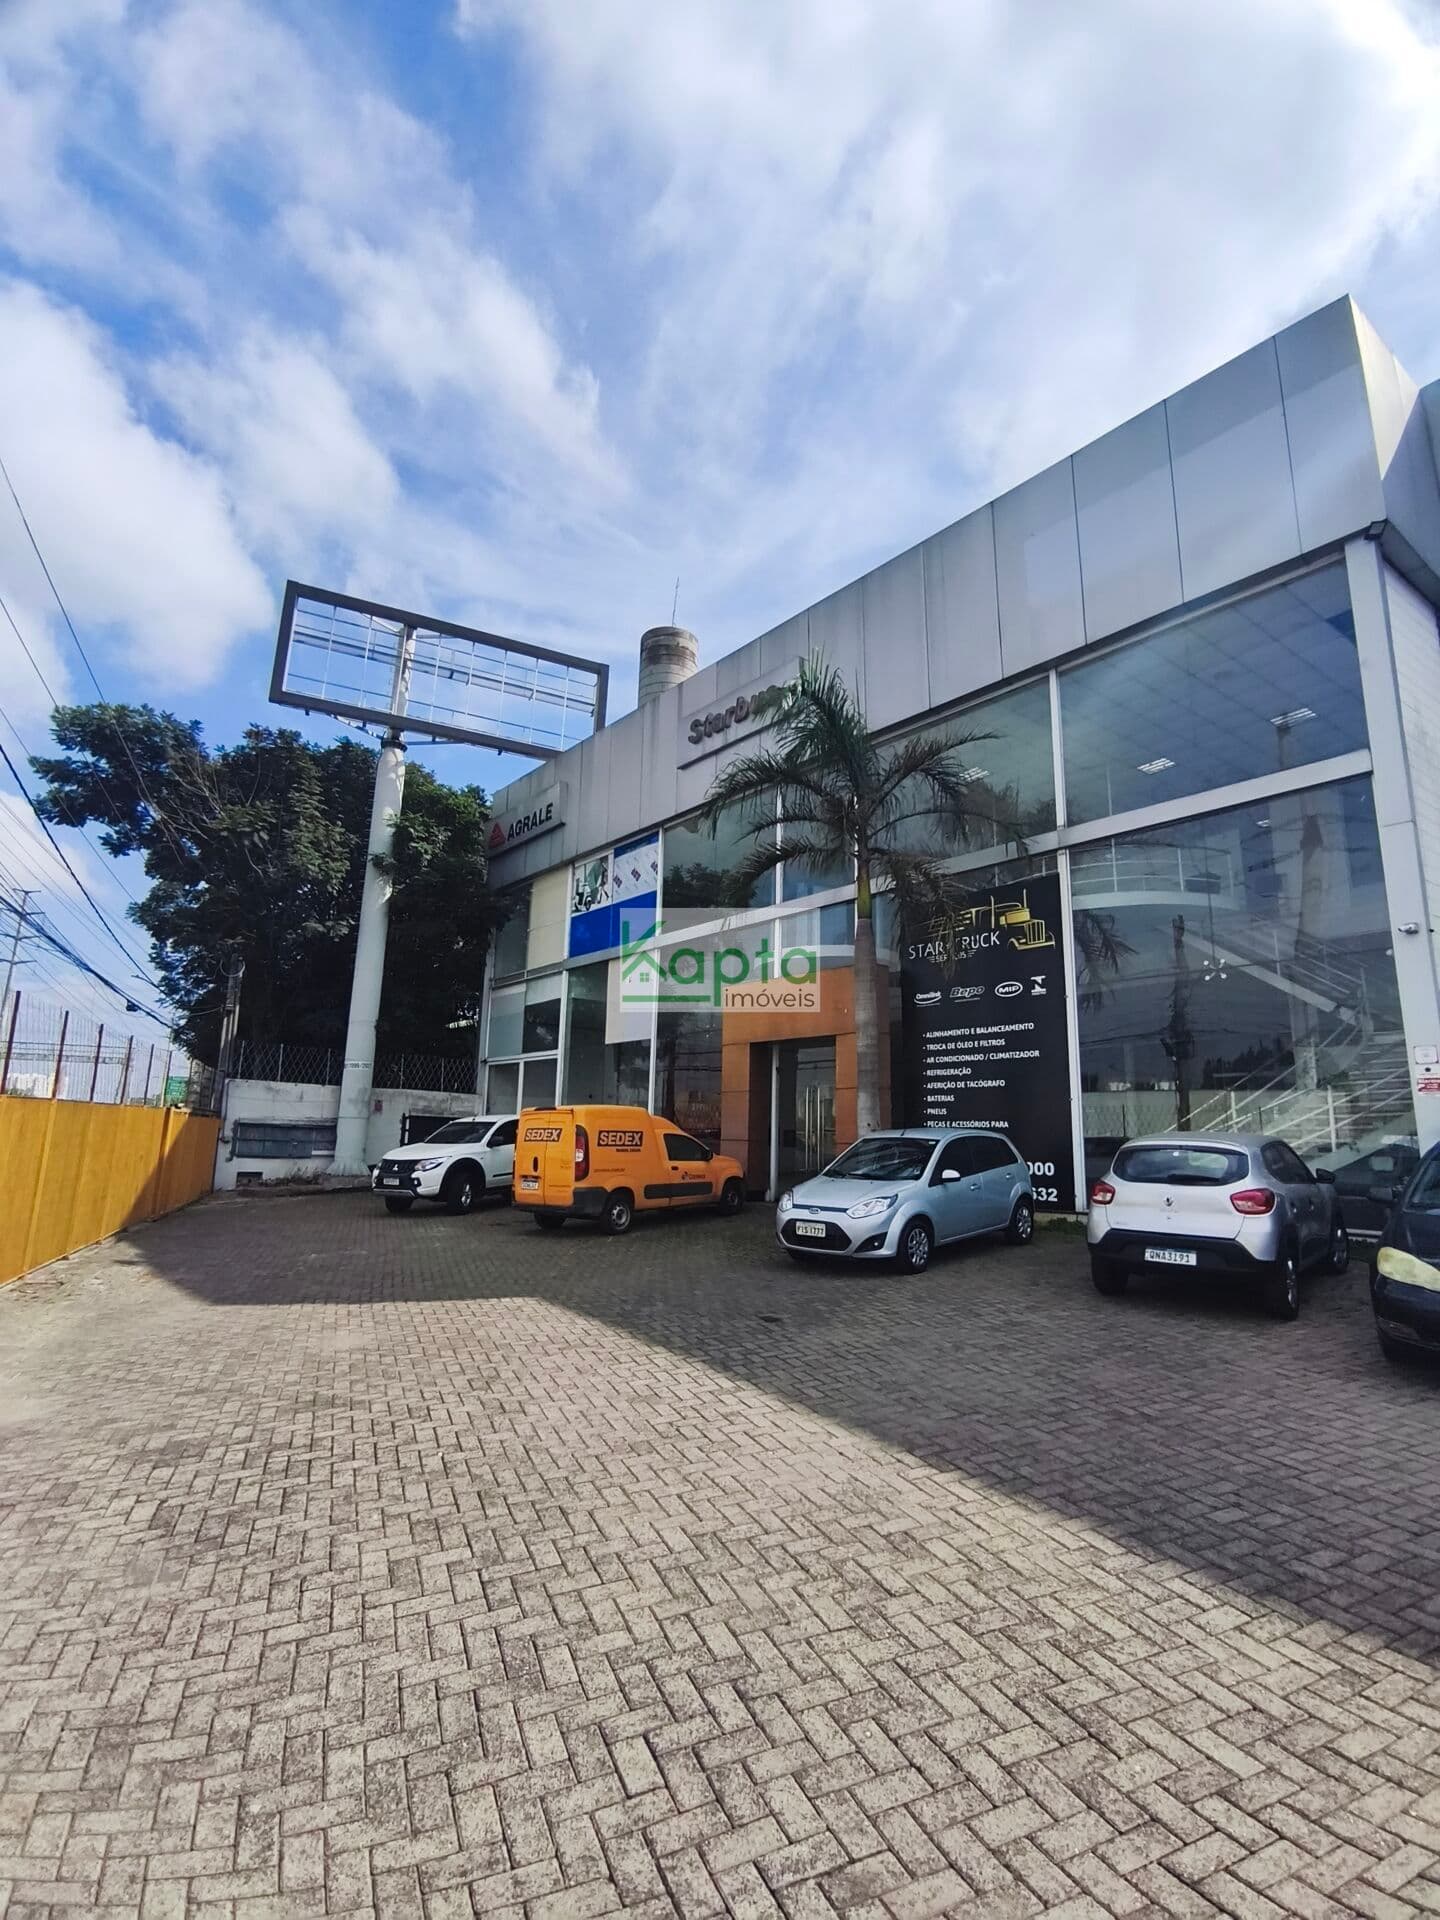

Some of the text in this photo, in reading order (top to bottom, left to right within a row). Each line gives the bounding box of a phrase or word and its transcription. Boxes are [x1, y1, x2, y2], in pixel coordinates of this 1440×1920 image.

[508, 802, 554, 841] AGRALE
[908, 941, 945, 959] STAR
[926, 1028, 970, 1038] ALINHAMENTO
[976, 1022, 1035, 1034] BALANCEAMENTO
[956, 1041, 973, 1049] ÓLEO
[979, 1038, 1006, 1047] FILTROS
[935, 1054, 984, 1063] CONDICIONADO
[989, 1050, 1040, 1060] CLIMATIZADOR
[926, 1066, 972, 1076] REFRIGERAÇÃO
[926, 1081, 956, 1090] AFERIÇÃO
[966, 1079, 1006, 1088] TACÓGRAFO
[951, 1120, 990, 1128] ACESSÓRIOS
[525, 1129, 560, 1140] SEDEX
[599, 1131, 642, 1145] SEDEX
